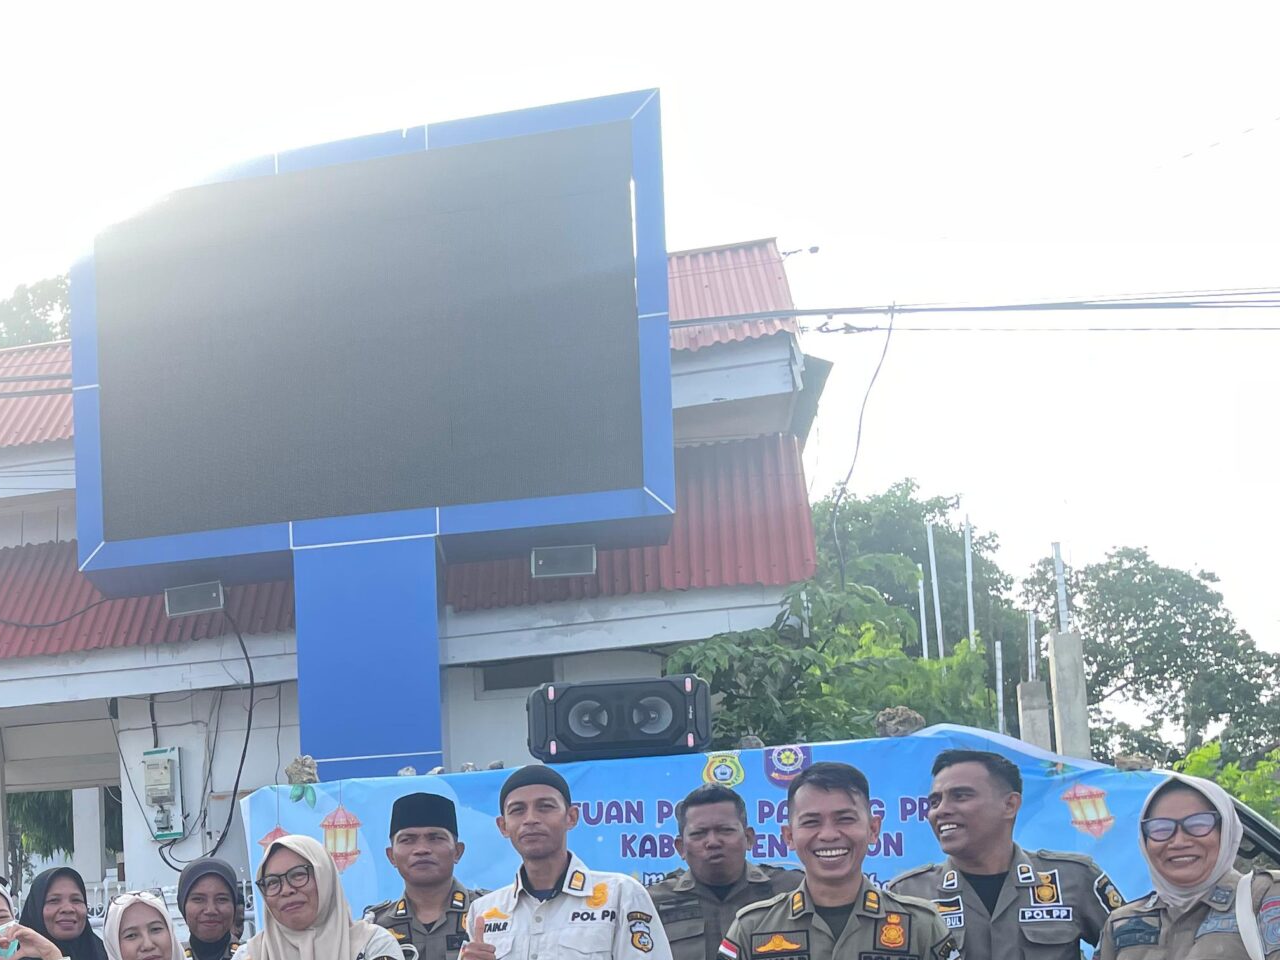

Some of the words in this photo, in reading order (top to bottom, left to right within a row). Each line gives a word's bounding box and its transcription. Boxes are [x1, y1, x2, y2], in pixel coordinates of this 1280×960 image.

[571, 911, 597, 922] POL
[1024, 911, 1050, 920] POL
[1052, 910, 1068, 919] PP
